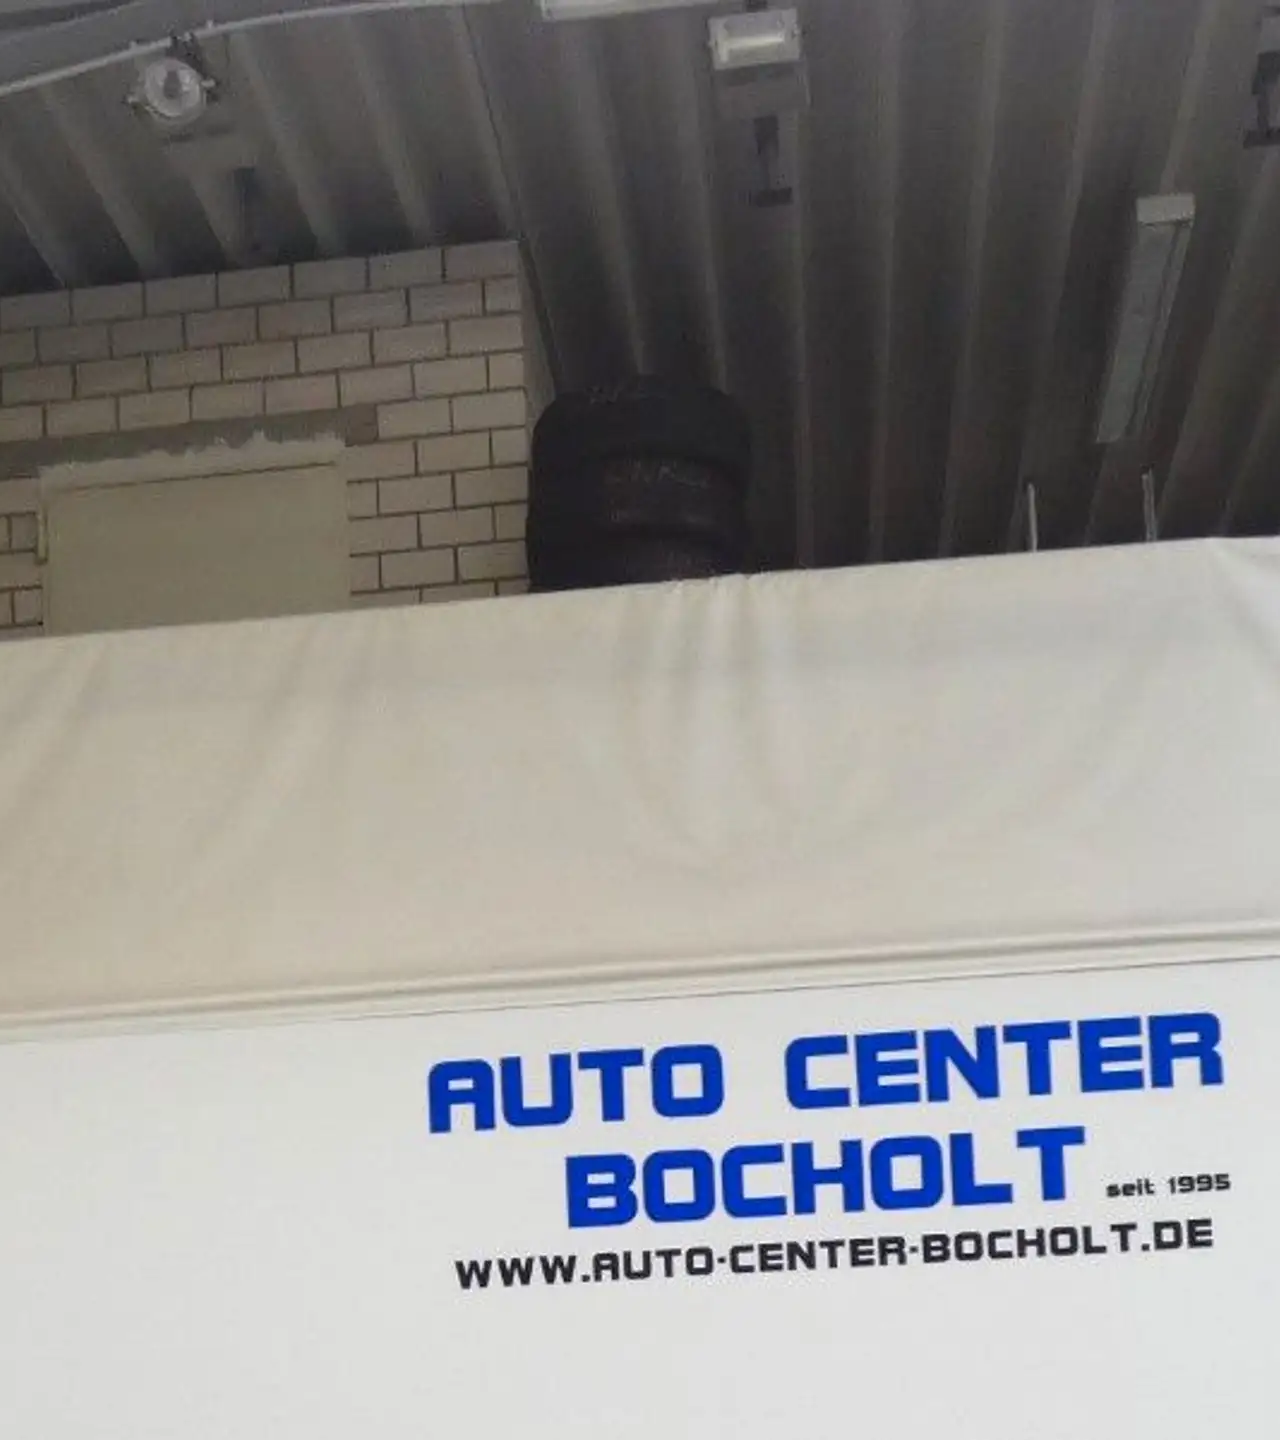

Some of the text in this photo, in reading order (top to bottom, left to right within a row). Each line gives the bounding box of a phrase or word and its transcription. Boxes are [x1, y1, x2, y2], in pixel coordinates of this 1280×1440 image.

[428, 1012, 1225, 1135] AUTO CENTER
[565, 1124, 1232, 1230] BOCHOLT seit 1995
[455, 1218, 1214, 1291] WWW.AUTO-CENTER-BOCHOLT.DE
